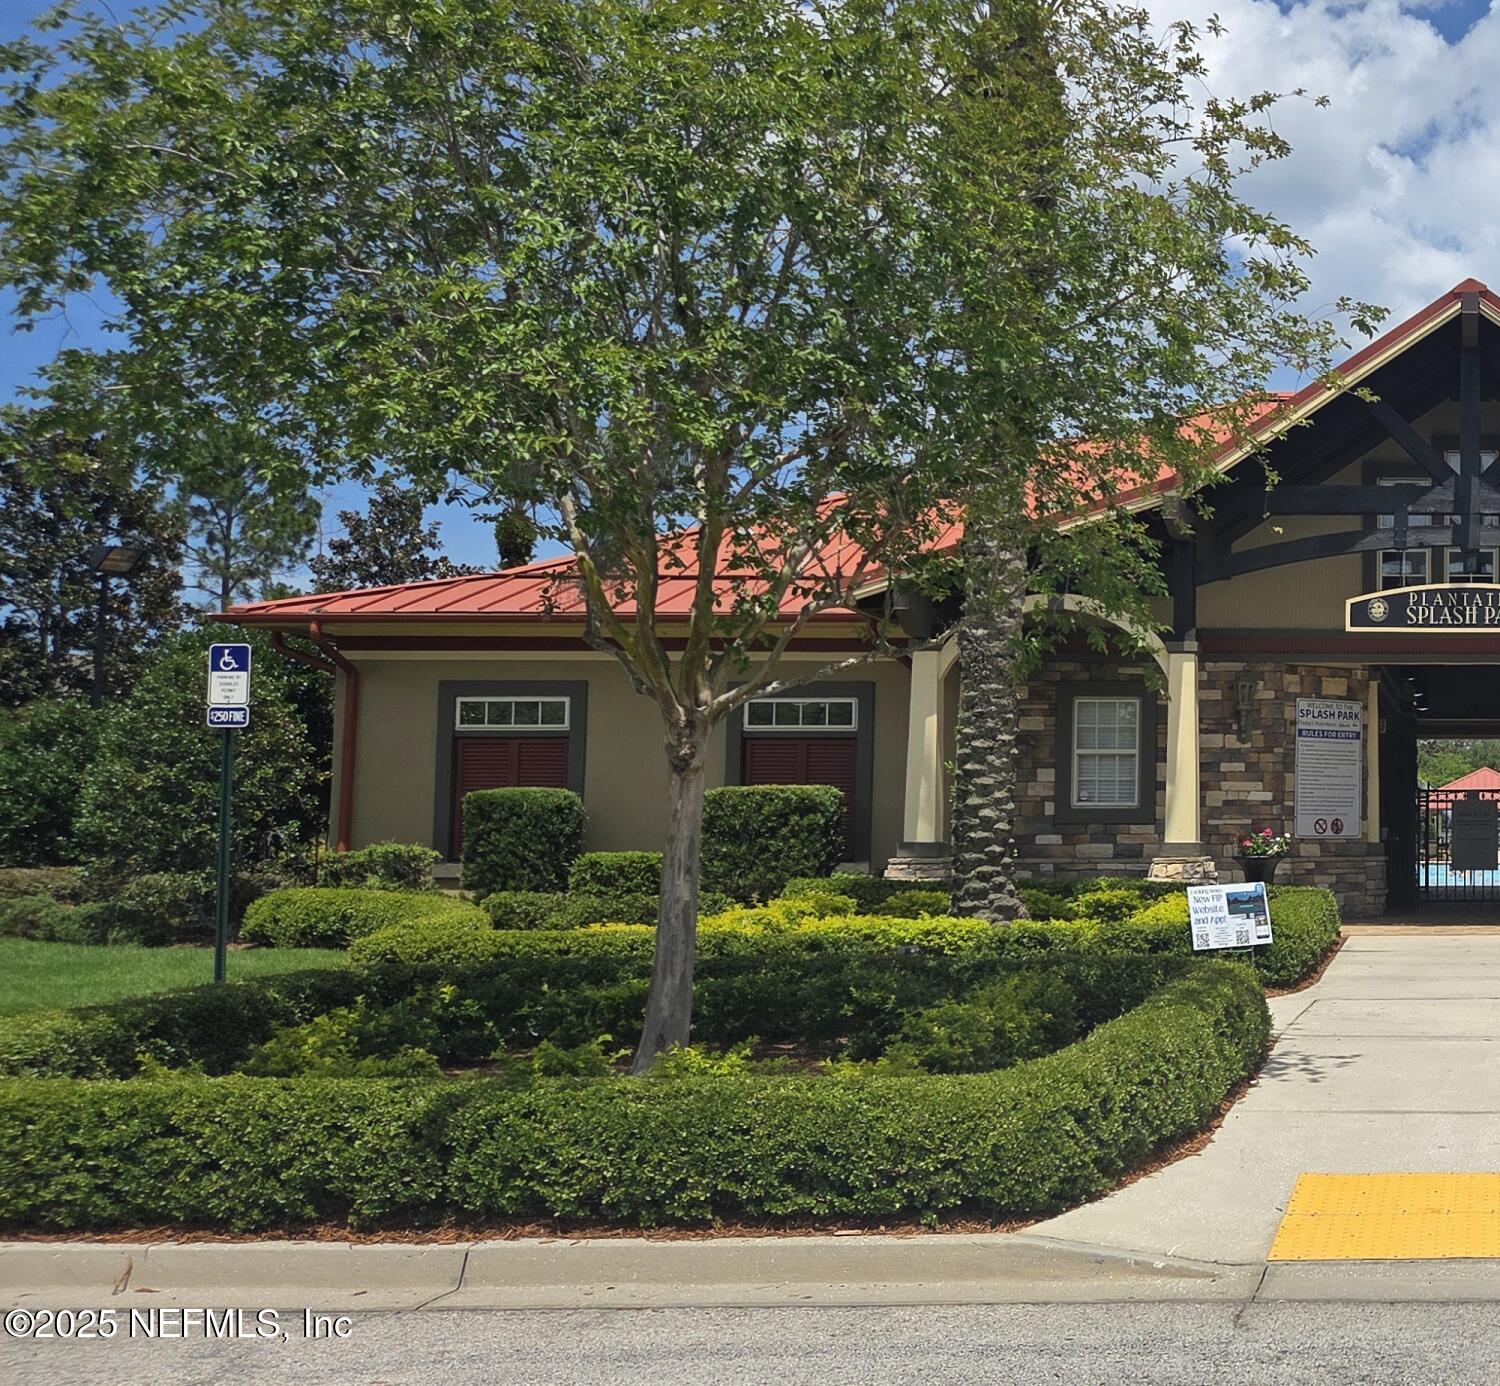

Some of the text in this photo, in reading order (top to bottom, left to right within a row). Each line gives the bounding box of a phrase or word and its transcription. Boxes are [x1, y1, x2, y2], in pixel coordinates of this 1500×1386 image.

[1406, 606, 1478, 624] SPLASH
[210, 711, 246, 722] $250 FINE
[1300, 709, 1360, 720] SPLASH PARK
[1192, 906, 1224, 914] Website
